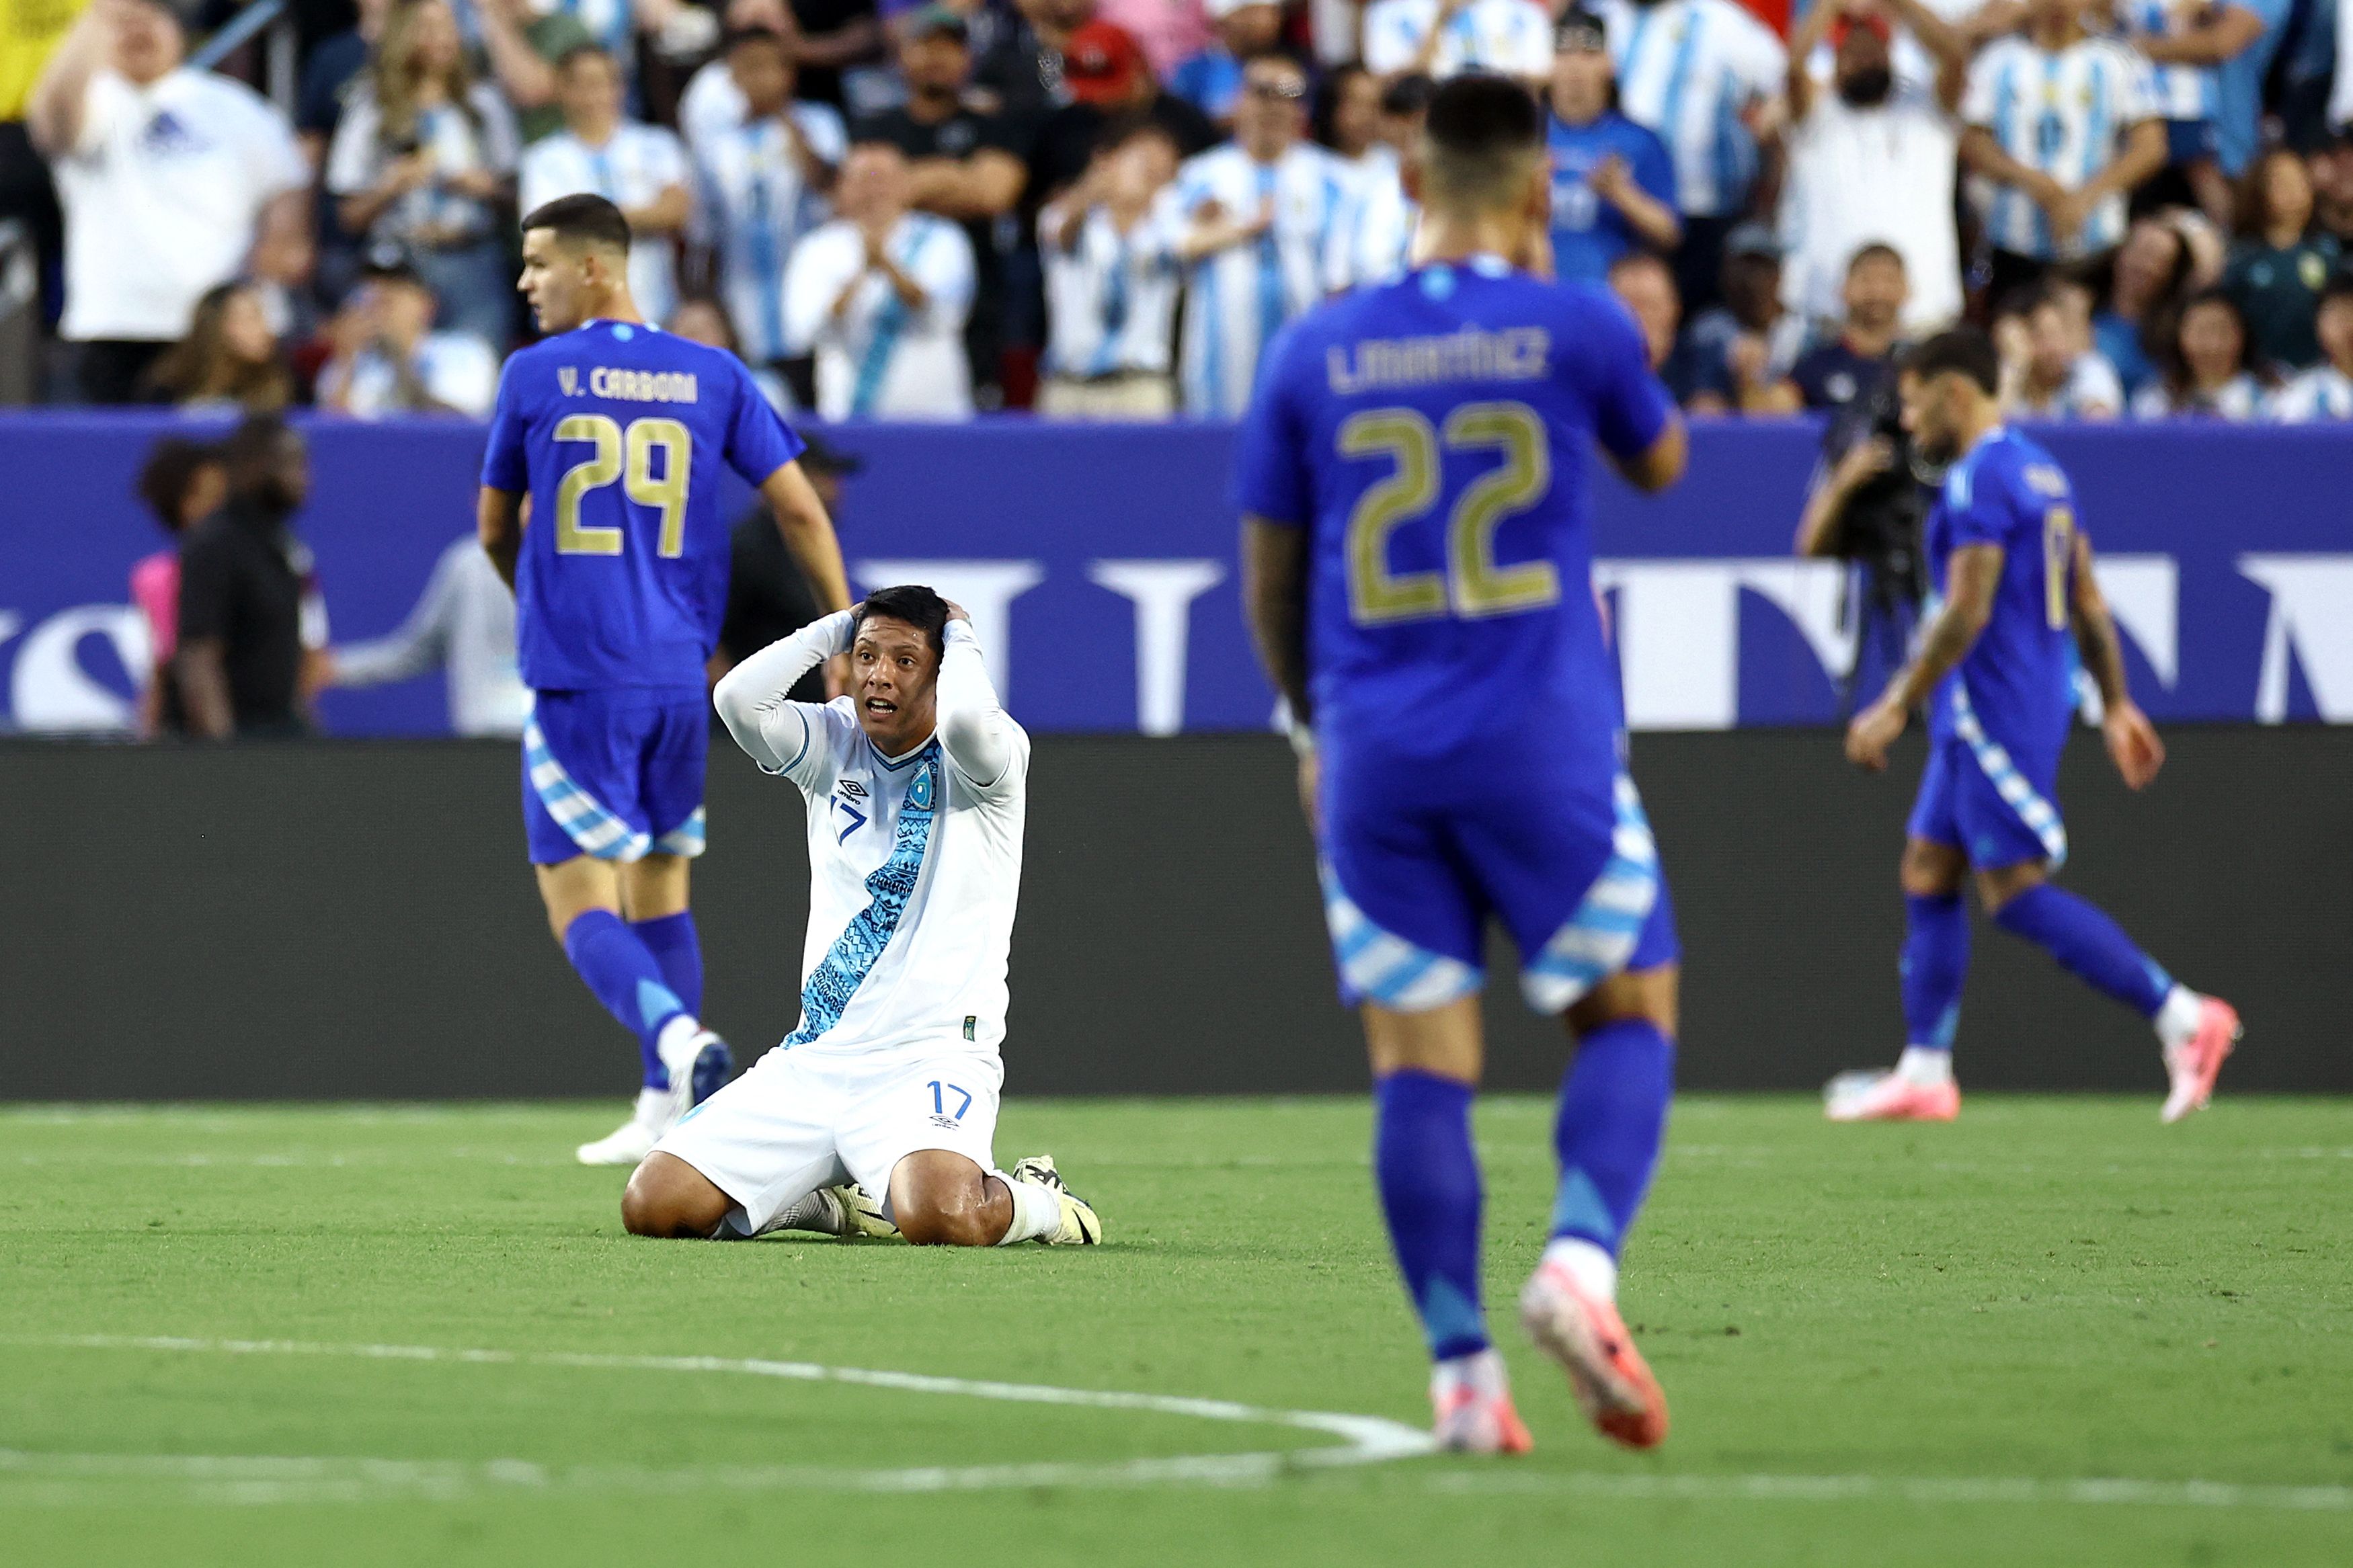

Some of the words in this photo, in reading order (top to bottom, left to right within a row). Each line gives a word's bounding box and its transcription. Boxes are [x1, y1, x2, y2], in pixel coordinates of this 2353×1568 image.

[557, 366, 586, 397] V.
[590, 366, 698, 403] CARBONI
[553, 413, 692, 559] 29
[1335, 401, 1561, 626] 22
[838, 789, 861, 805] umbro
[927, 1081, 971, 1120] 17
